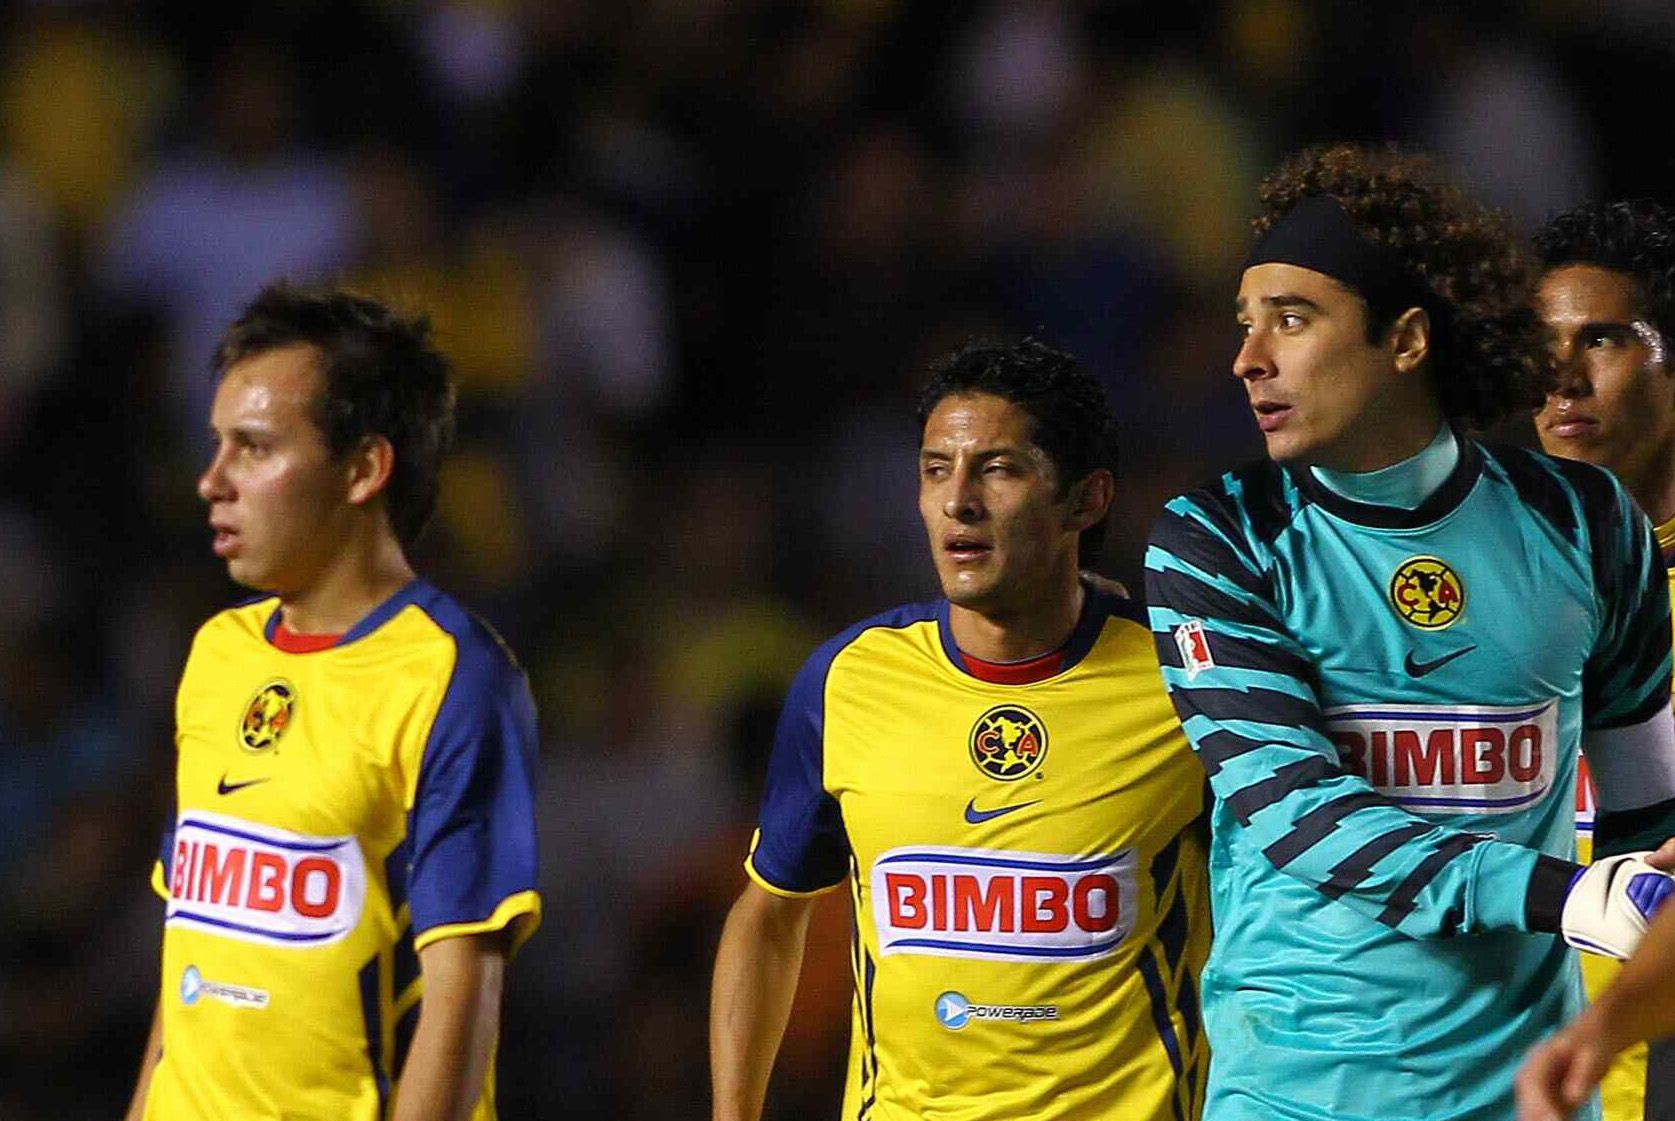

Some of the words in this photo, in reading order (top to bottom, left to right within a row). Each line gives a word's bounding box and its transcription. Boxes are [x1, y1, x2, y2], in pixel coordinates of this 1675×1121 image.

[1331, 724, 1542, 787] BIMBO
[173, 840, 341, 918] BIMBO
[886, 872, 1120, 933] BIMBO
